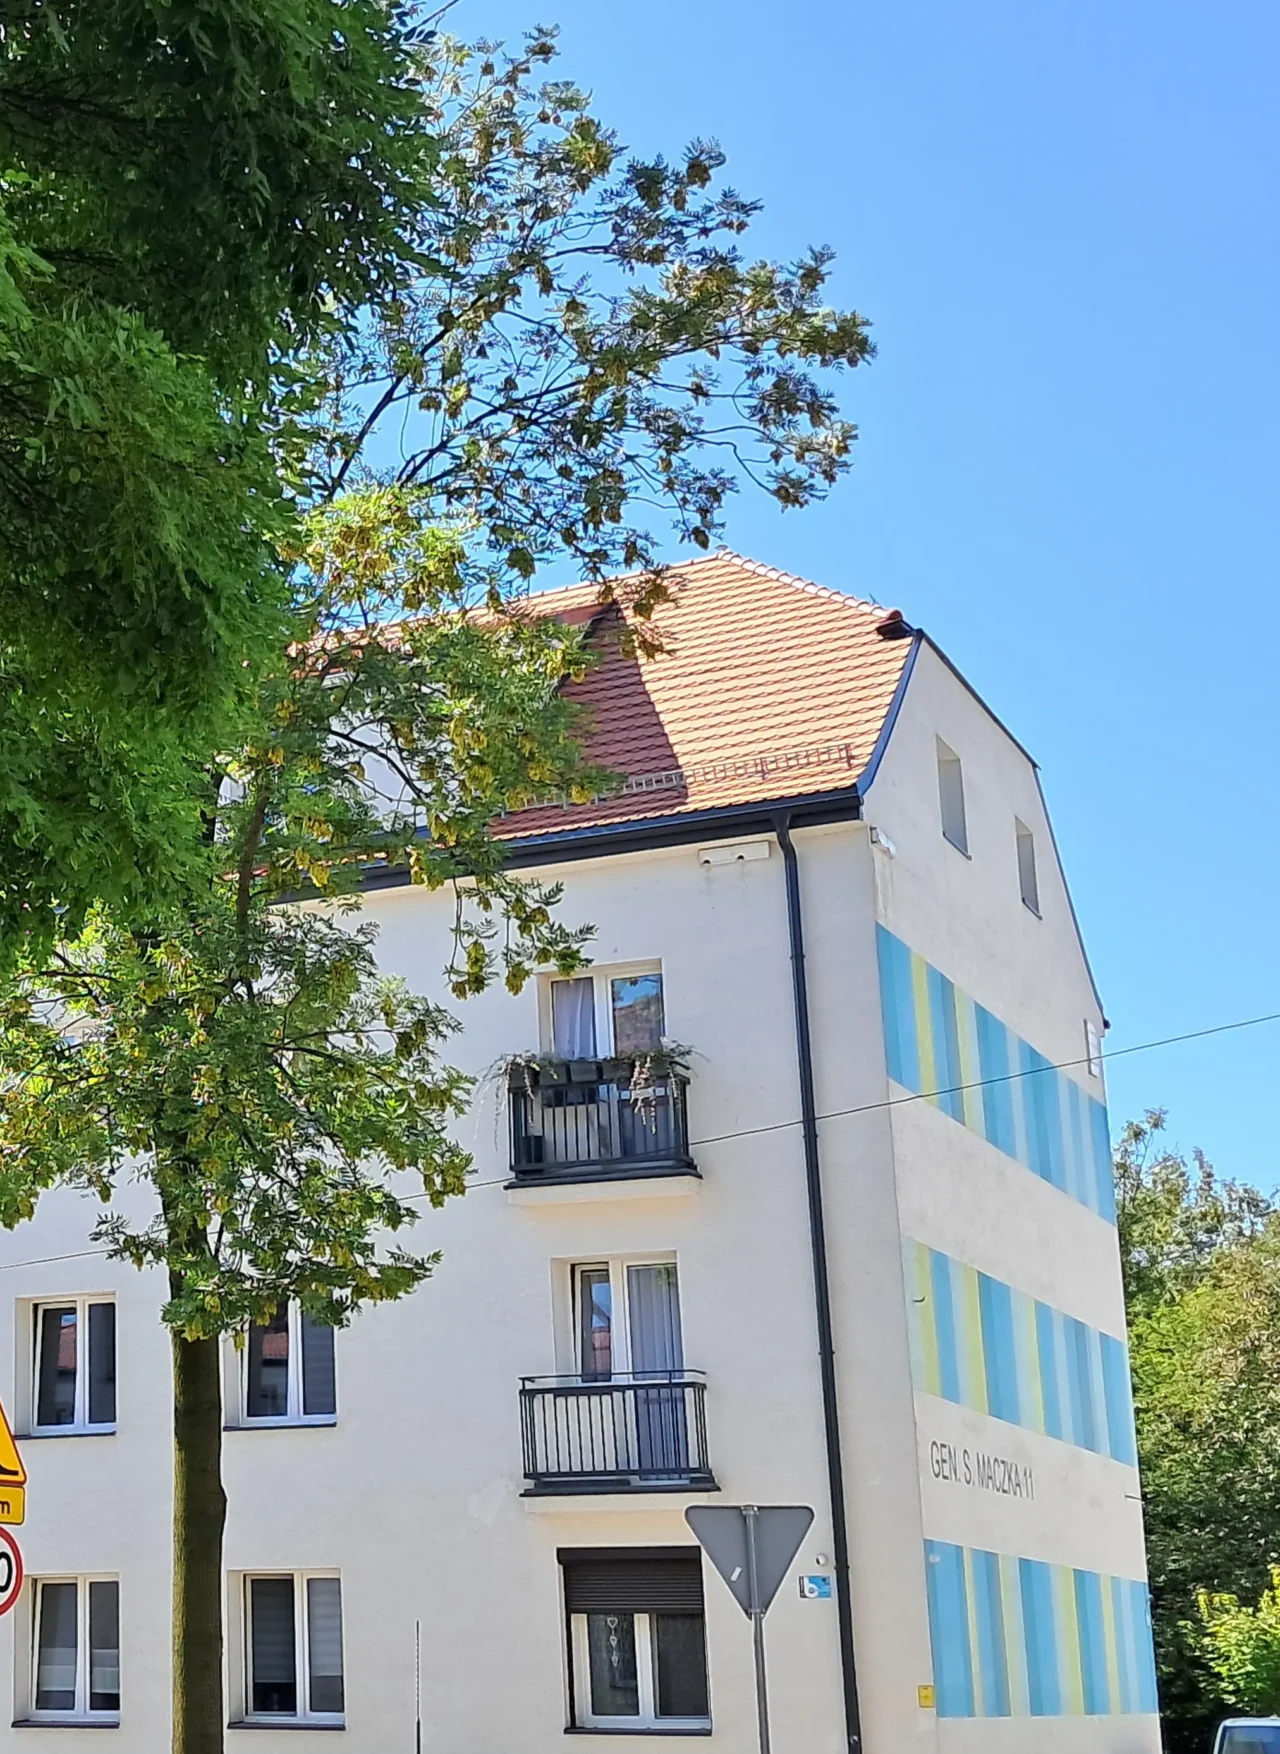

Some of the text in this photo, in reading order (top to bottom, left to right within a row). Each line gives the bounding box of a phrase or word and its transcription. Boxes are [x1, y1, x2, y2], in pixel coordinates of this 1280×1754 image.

[930, 1440, 1035, 1501] GEN. S. MACZKA 11
